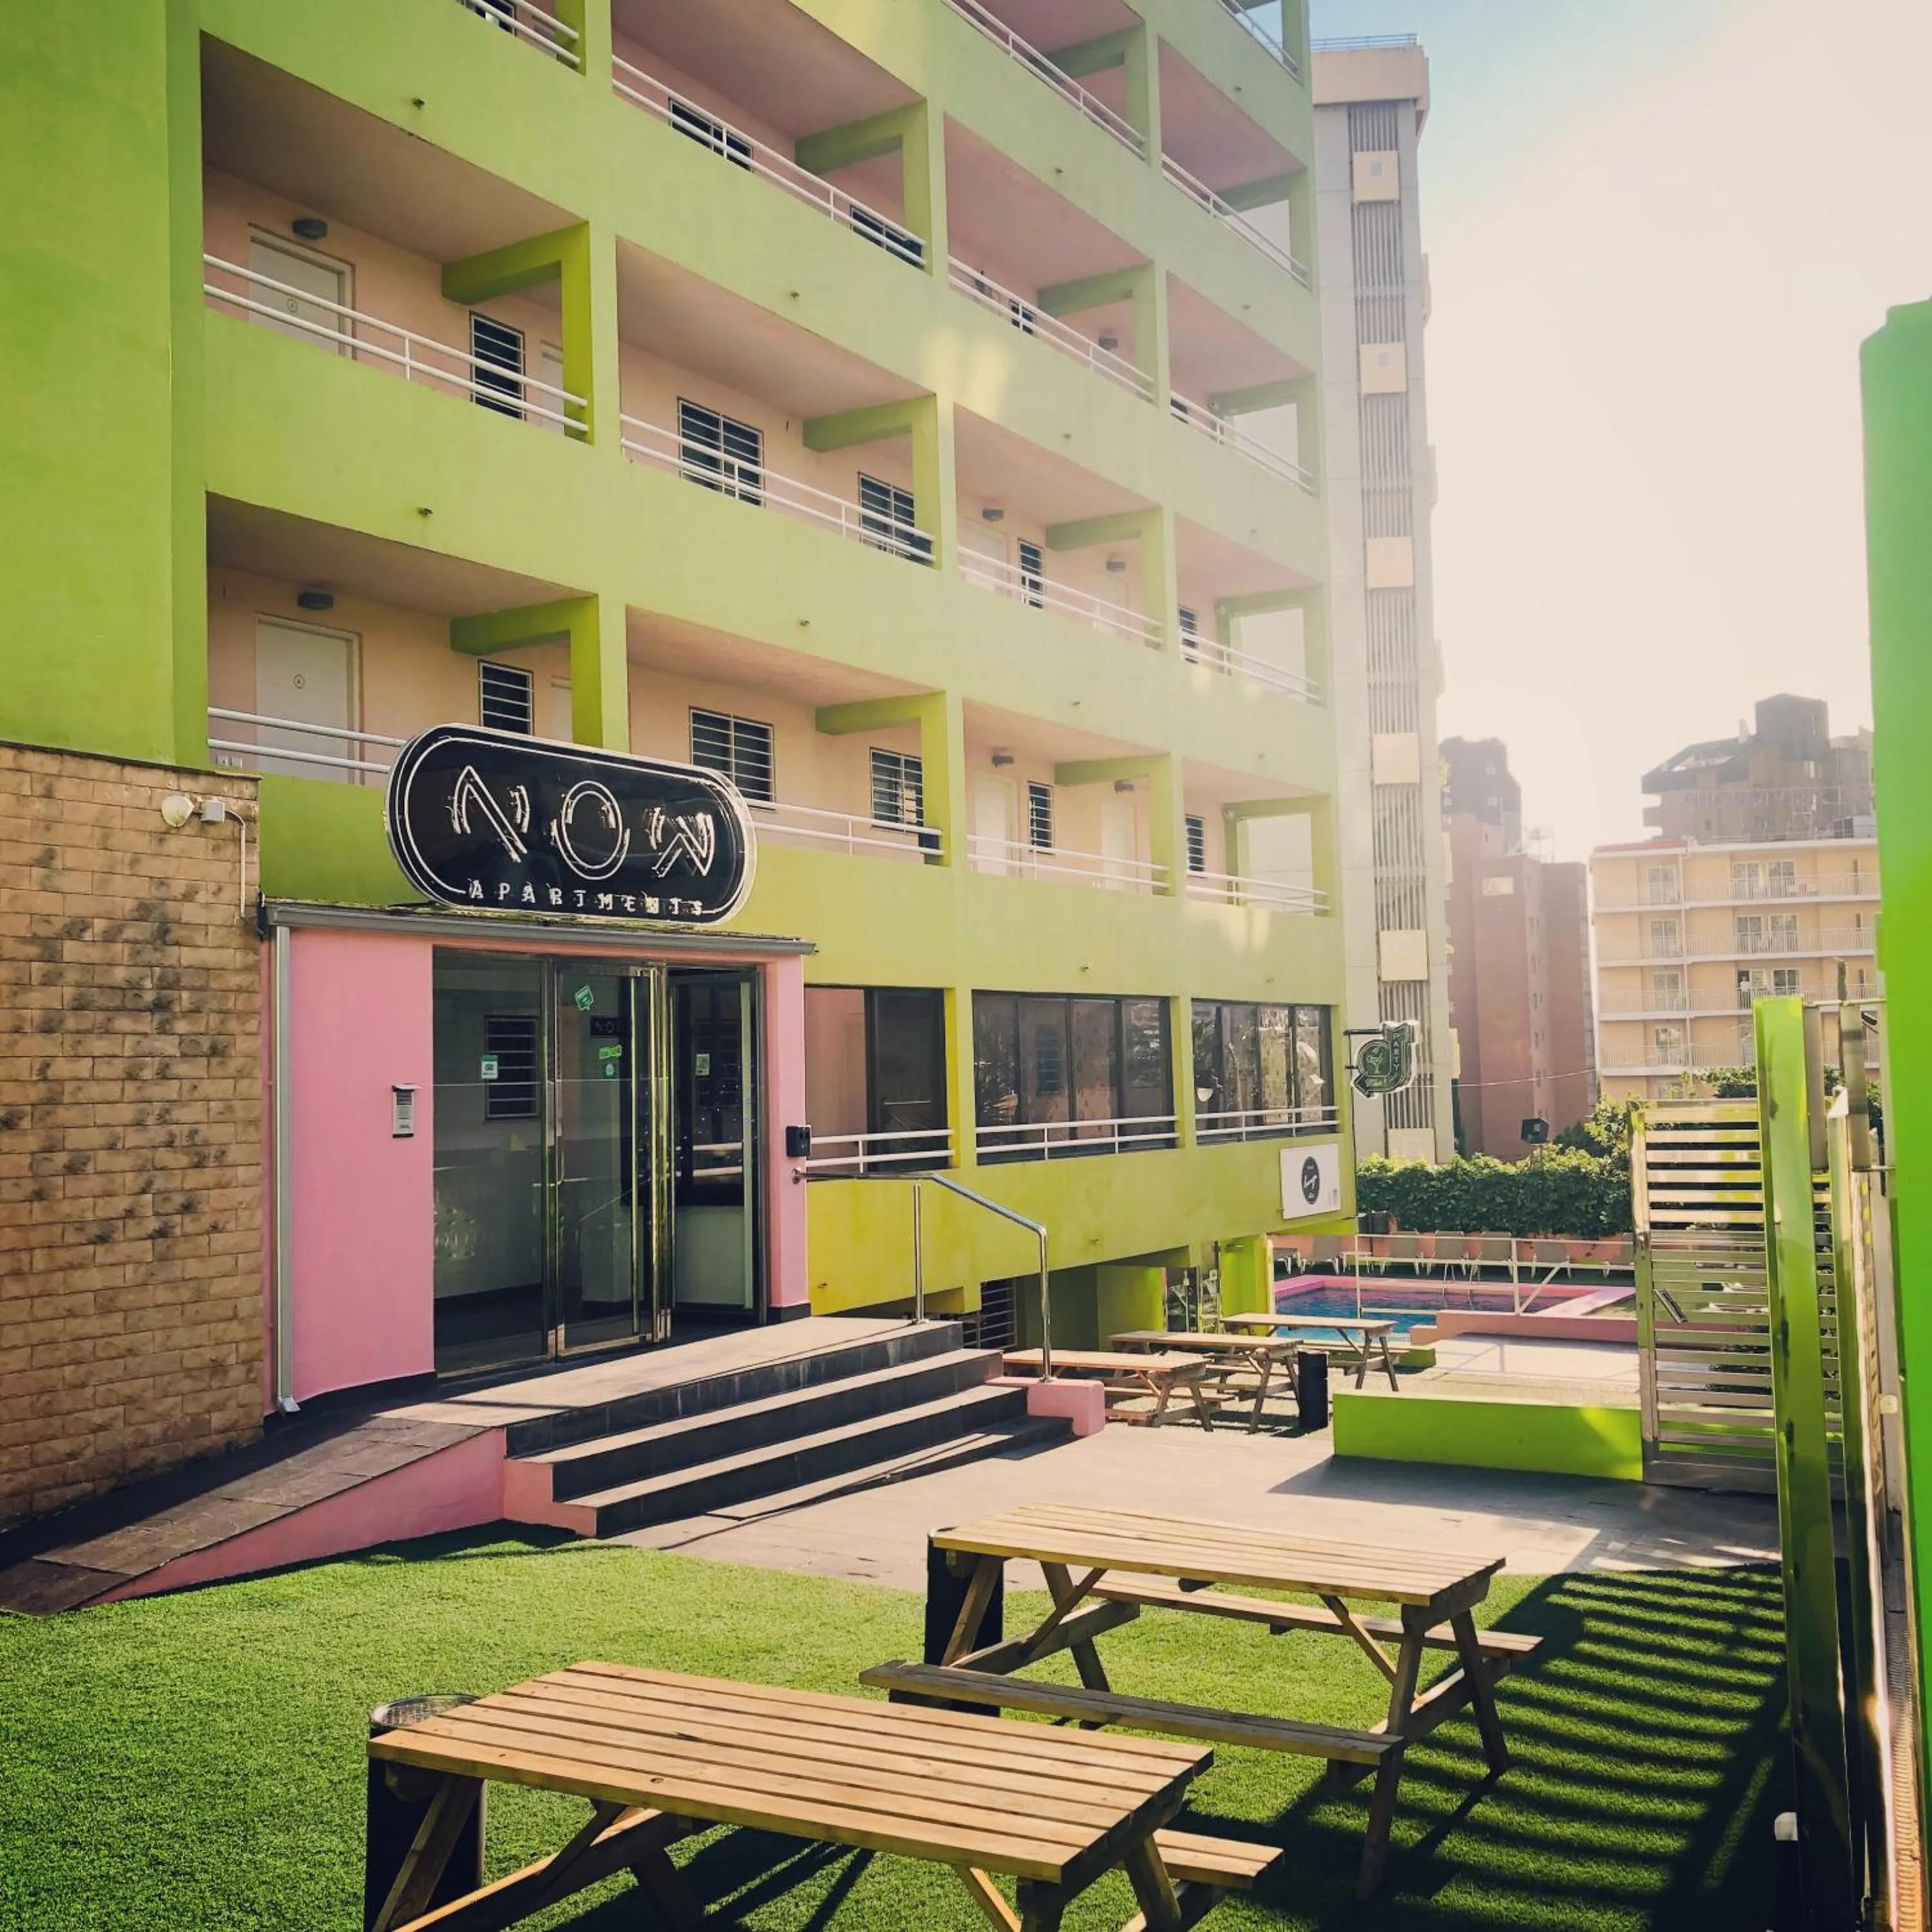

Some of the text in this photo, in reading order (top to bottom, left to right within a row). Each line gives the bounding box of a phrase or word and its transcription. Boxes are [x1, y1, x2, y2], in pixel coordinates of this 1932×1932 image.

[452, 764, 715, 880] NOW
[468, 879, 703, 915] APARTMENTS
[1392, 1032, 1402, 1070] PARTY
